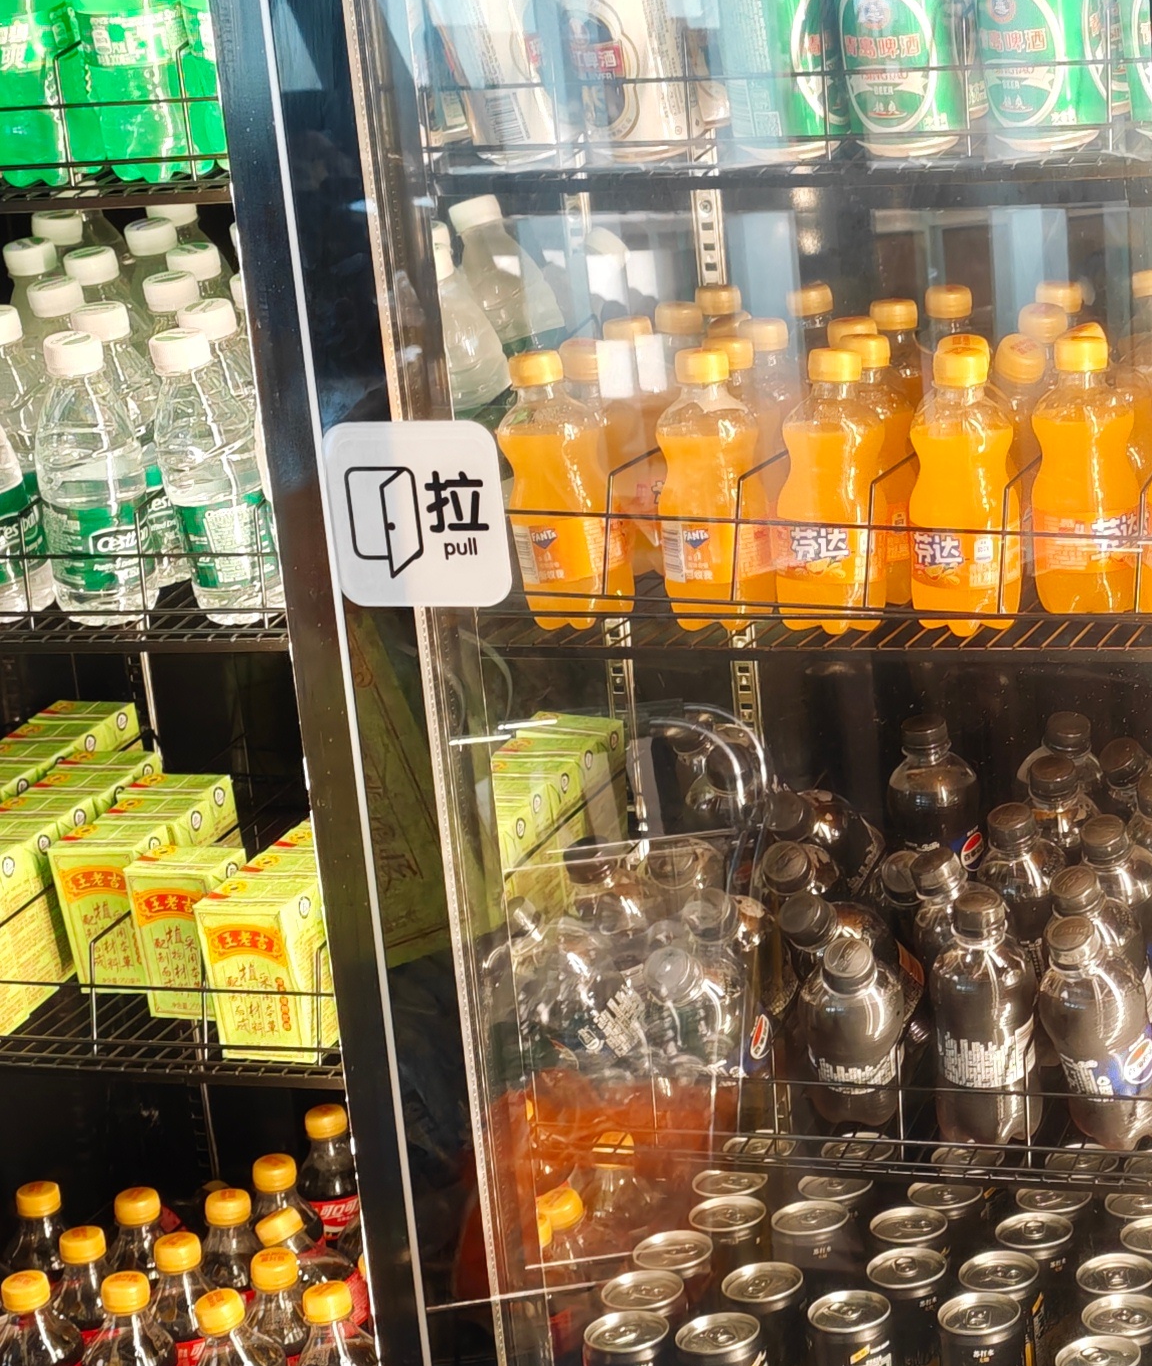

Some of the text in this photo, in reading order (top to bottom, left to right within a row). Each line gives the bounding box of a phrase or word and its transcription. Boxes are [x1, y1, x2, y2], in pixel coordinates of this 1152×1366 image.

[845, 34, 921, 58] 青岛啤酒
[872, 85, 894, 96] BEER
[425, 471, 490, 534] 拉
[531, 529, 557, 543] FANTA
[790, 526, 850, 562] 芬达
[443, 539, 478, 559] pull
[914, 531, 964, 565] 芬达
[77, 871, 122, 889] 王老吉
[149, 894, 194, 912] 王老吉
[93, 899, 120, 973] 植材料
[223, 930, 268, 947] 王老吉
[239, 963, 265, 1036] 植材料
[319, 1198, 358, 1217] 可口可
